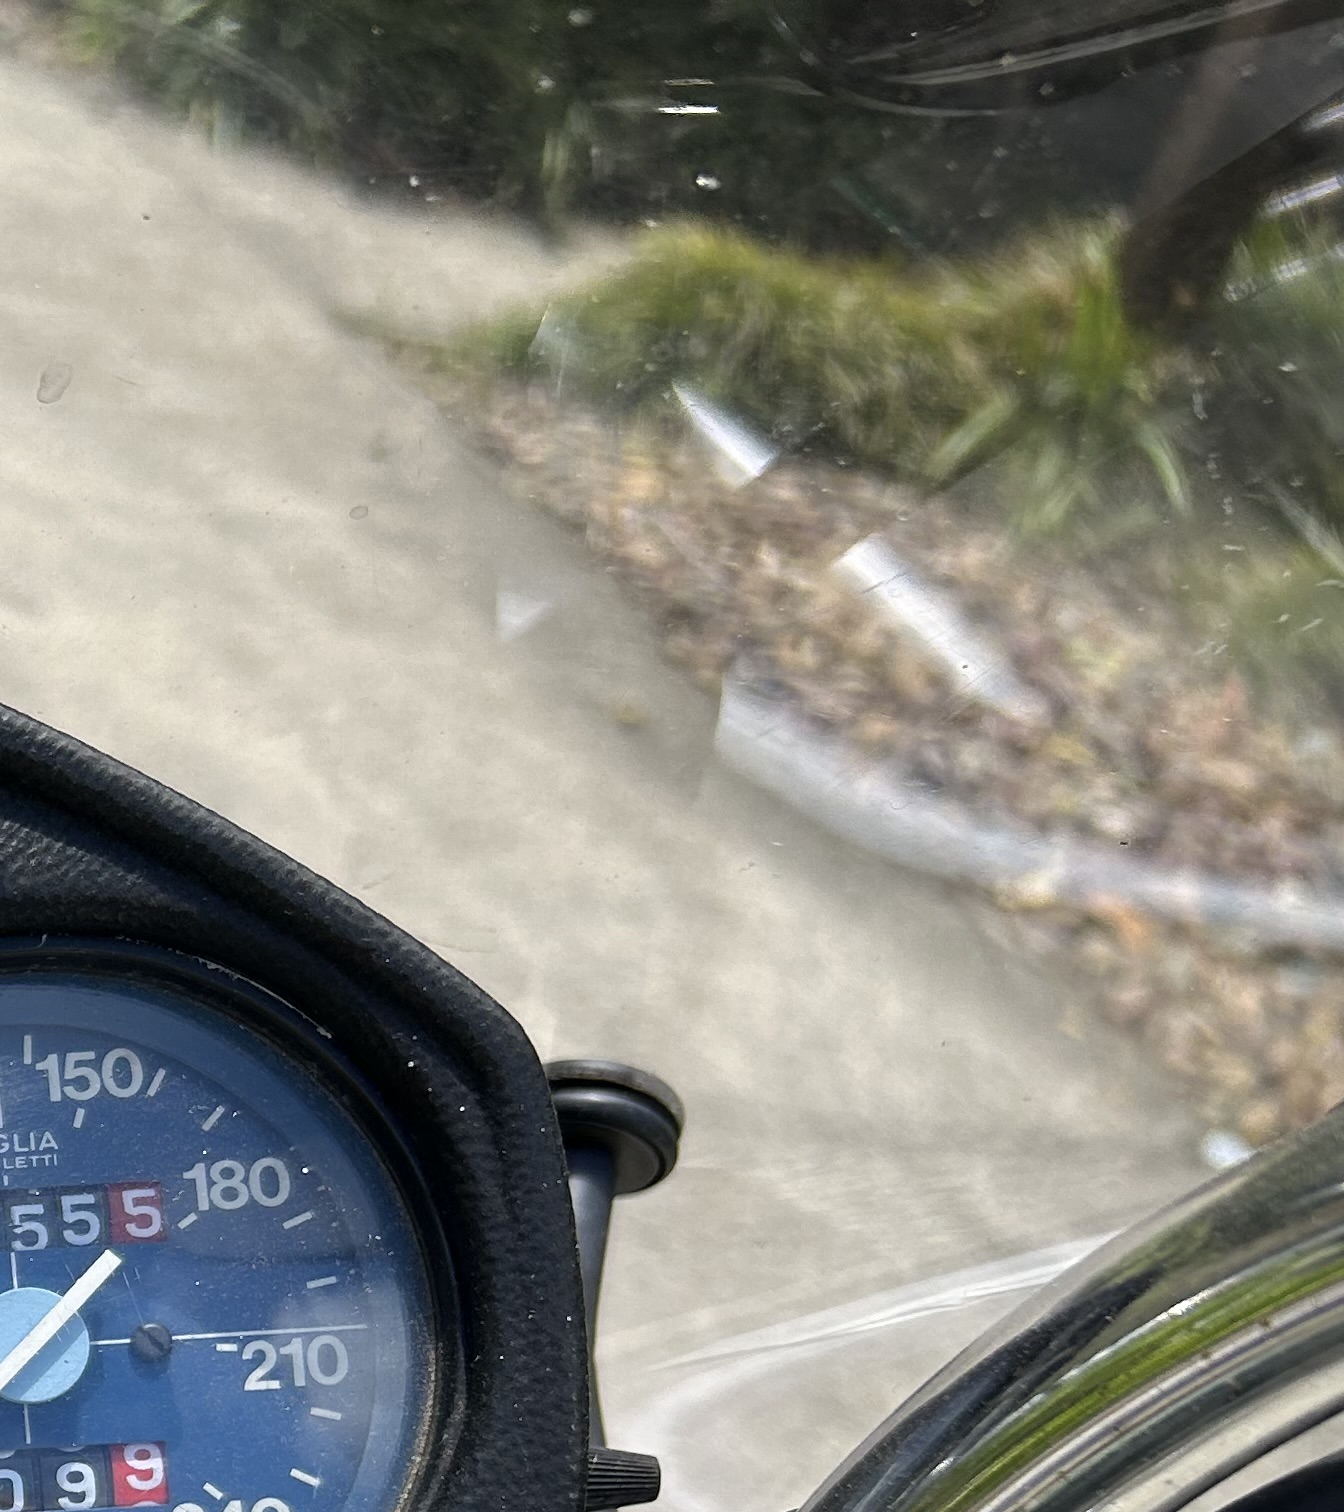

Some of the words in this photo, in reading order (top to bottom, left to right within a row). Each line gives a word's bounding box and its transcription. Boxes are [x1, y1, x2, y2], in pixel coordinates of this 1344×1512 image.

[34, 1047, 143, 1102] 150
[184, 1157, 291, 1210] 180
[241, 1337, 348, 1391] 210
